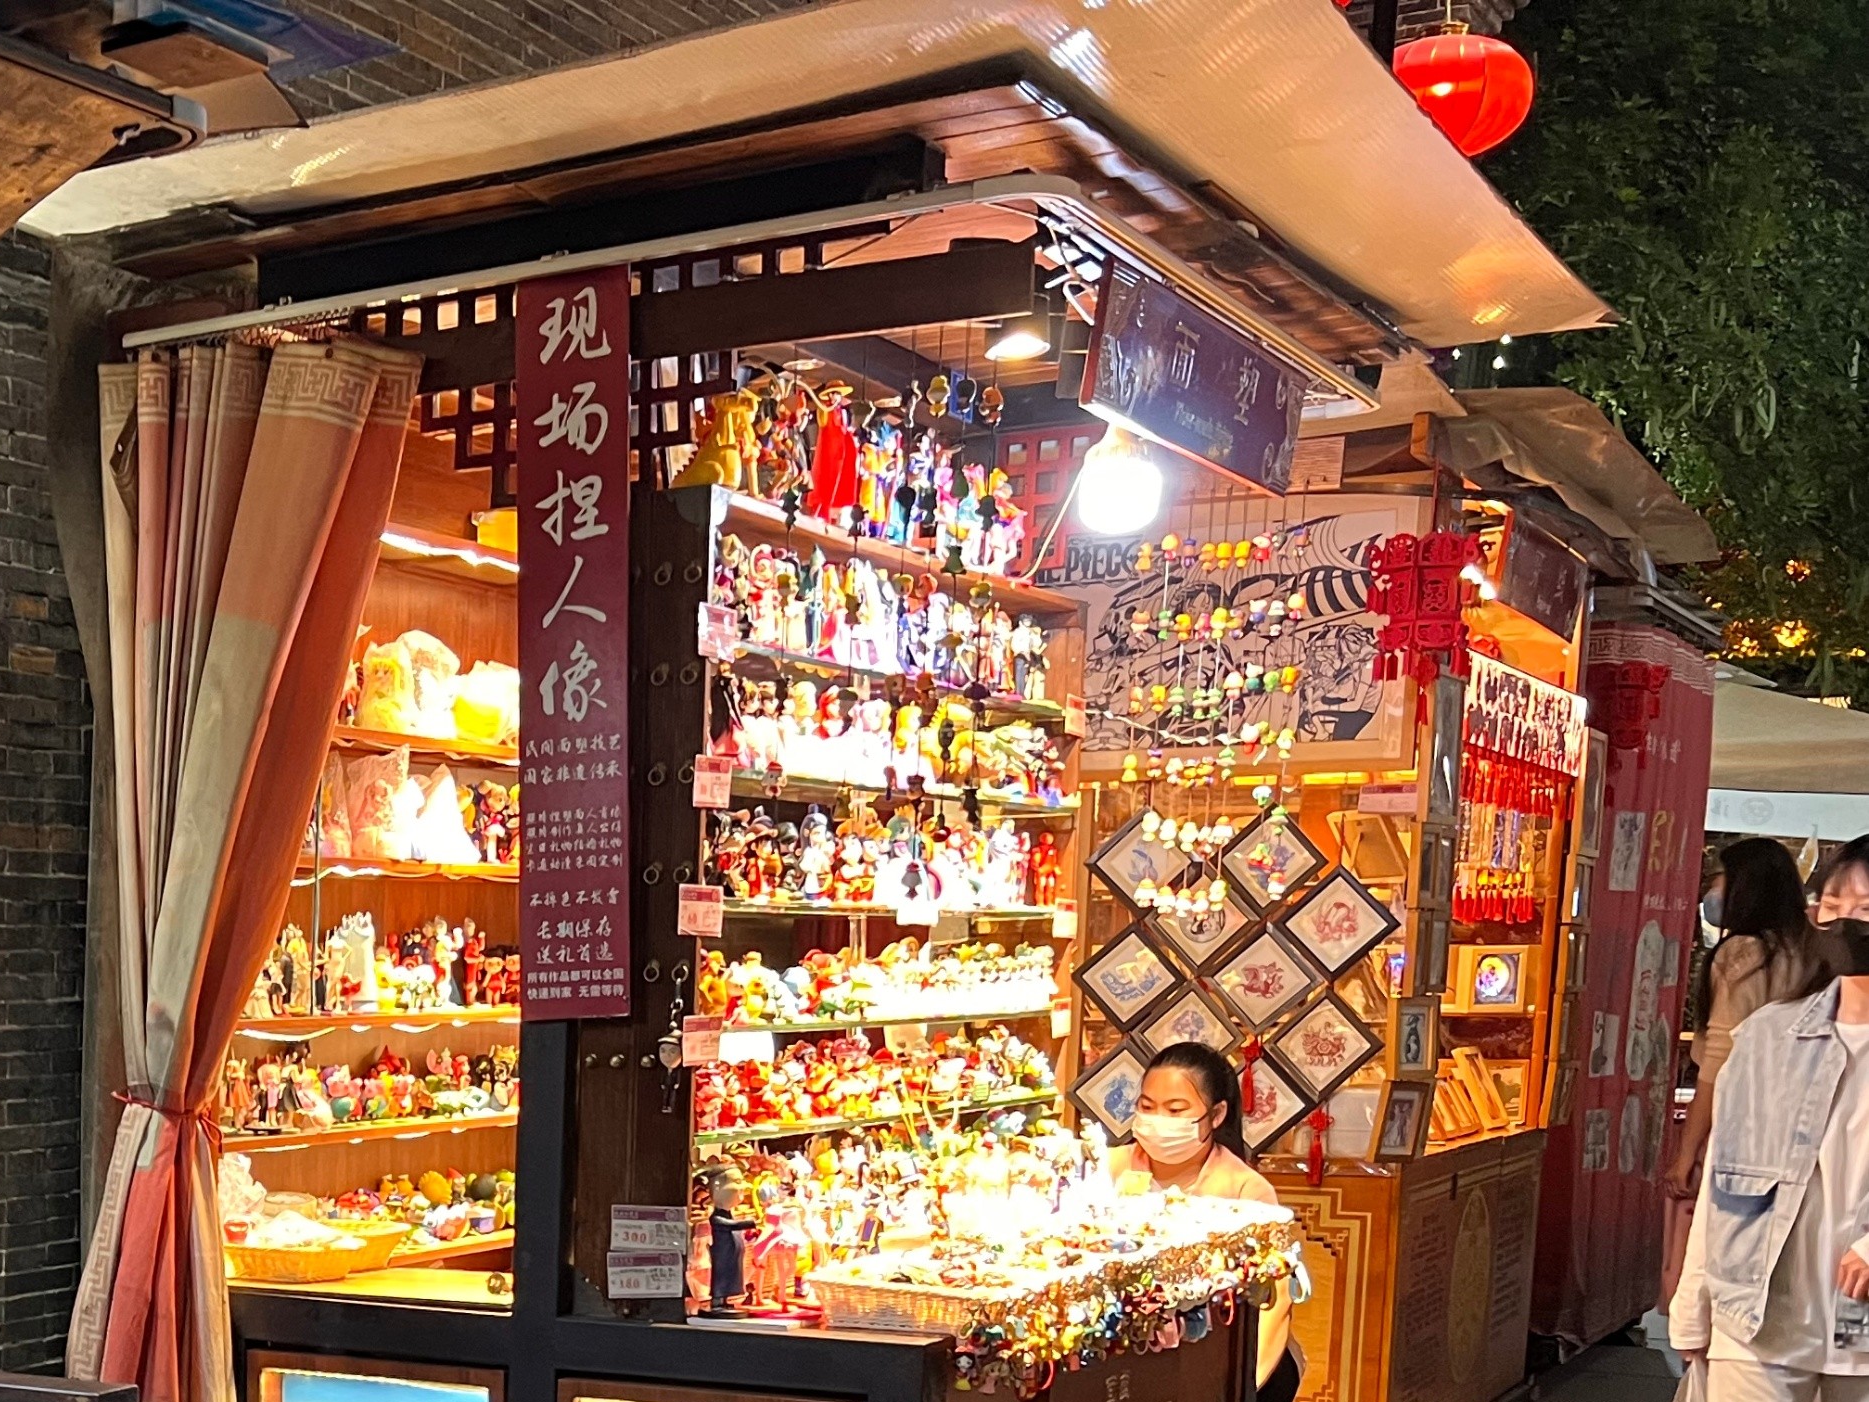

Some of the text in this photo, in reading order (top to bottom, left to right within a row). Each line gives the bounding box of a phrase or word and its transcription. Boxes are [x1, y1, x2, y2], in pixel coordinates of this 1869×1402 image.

[533, 287, 611, 722] 现场捏人像
[526, 733, 621, 758] 民间面塑技艺
[524, 759, 623, 785] 国家非遗传承
[529, 887, 620, 908] 不掉色不发霉
[537, 915, 612, 940] 长期保存
[537, 940, 614, 964] 送礼首选
[527, 968, 624, 984] 所有作品都可以全国
[527, 984, 625, 1000] 快递到家 无需等待
